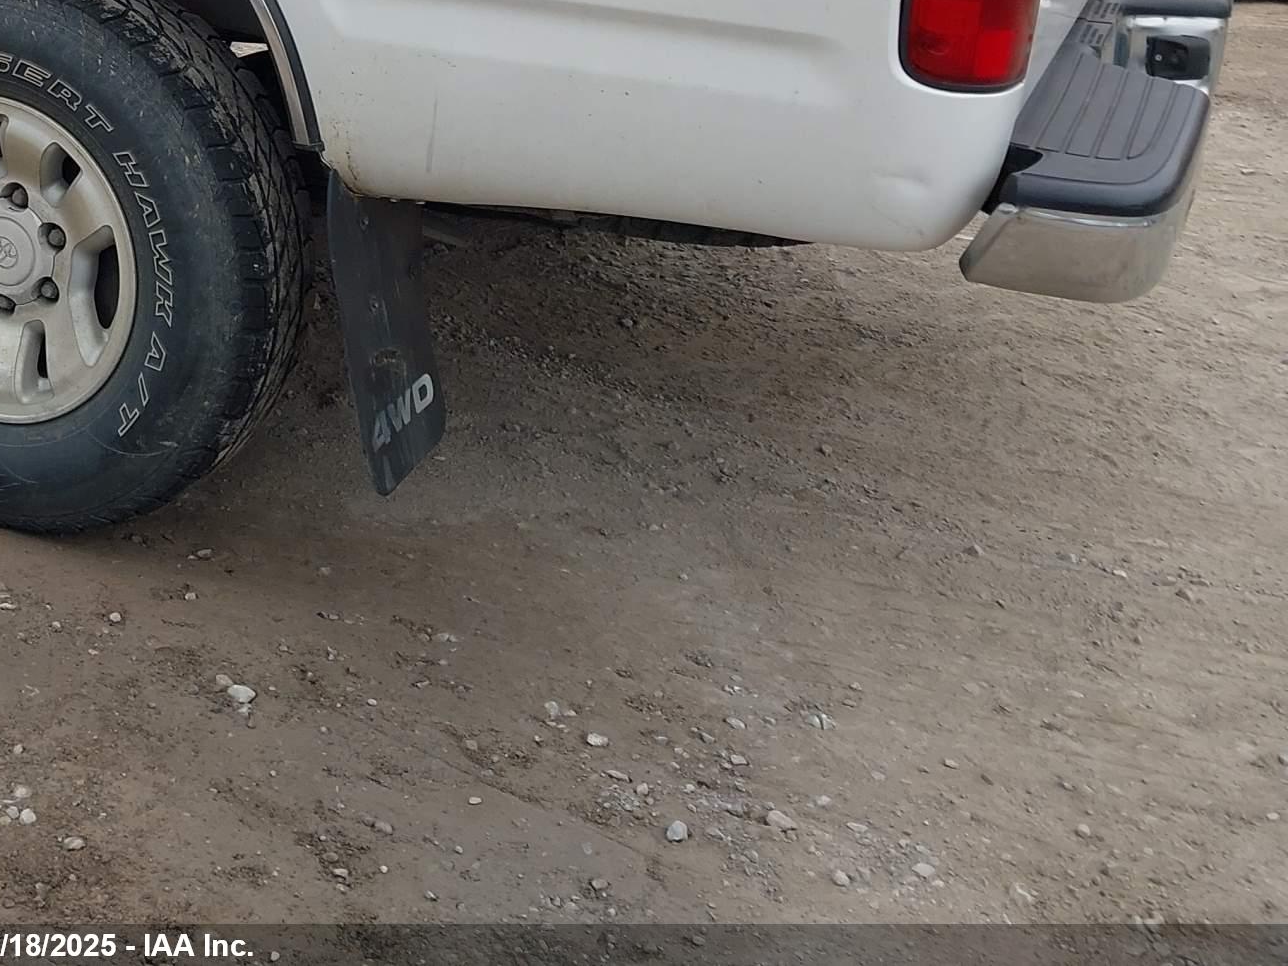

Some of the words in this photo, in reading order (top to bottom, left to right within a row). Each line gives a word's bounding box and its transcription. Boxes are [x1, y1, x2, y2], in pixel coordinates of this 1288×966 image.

[112, 151, 175, 328] HAWK
[116, 331, 167, 437] A/T
[372, 373, 434, 453] 4WD
